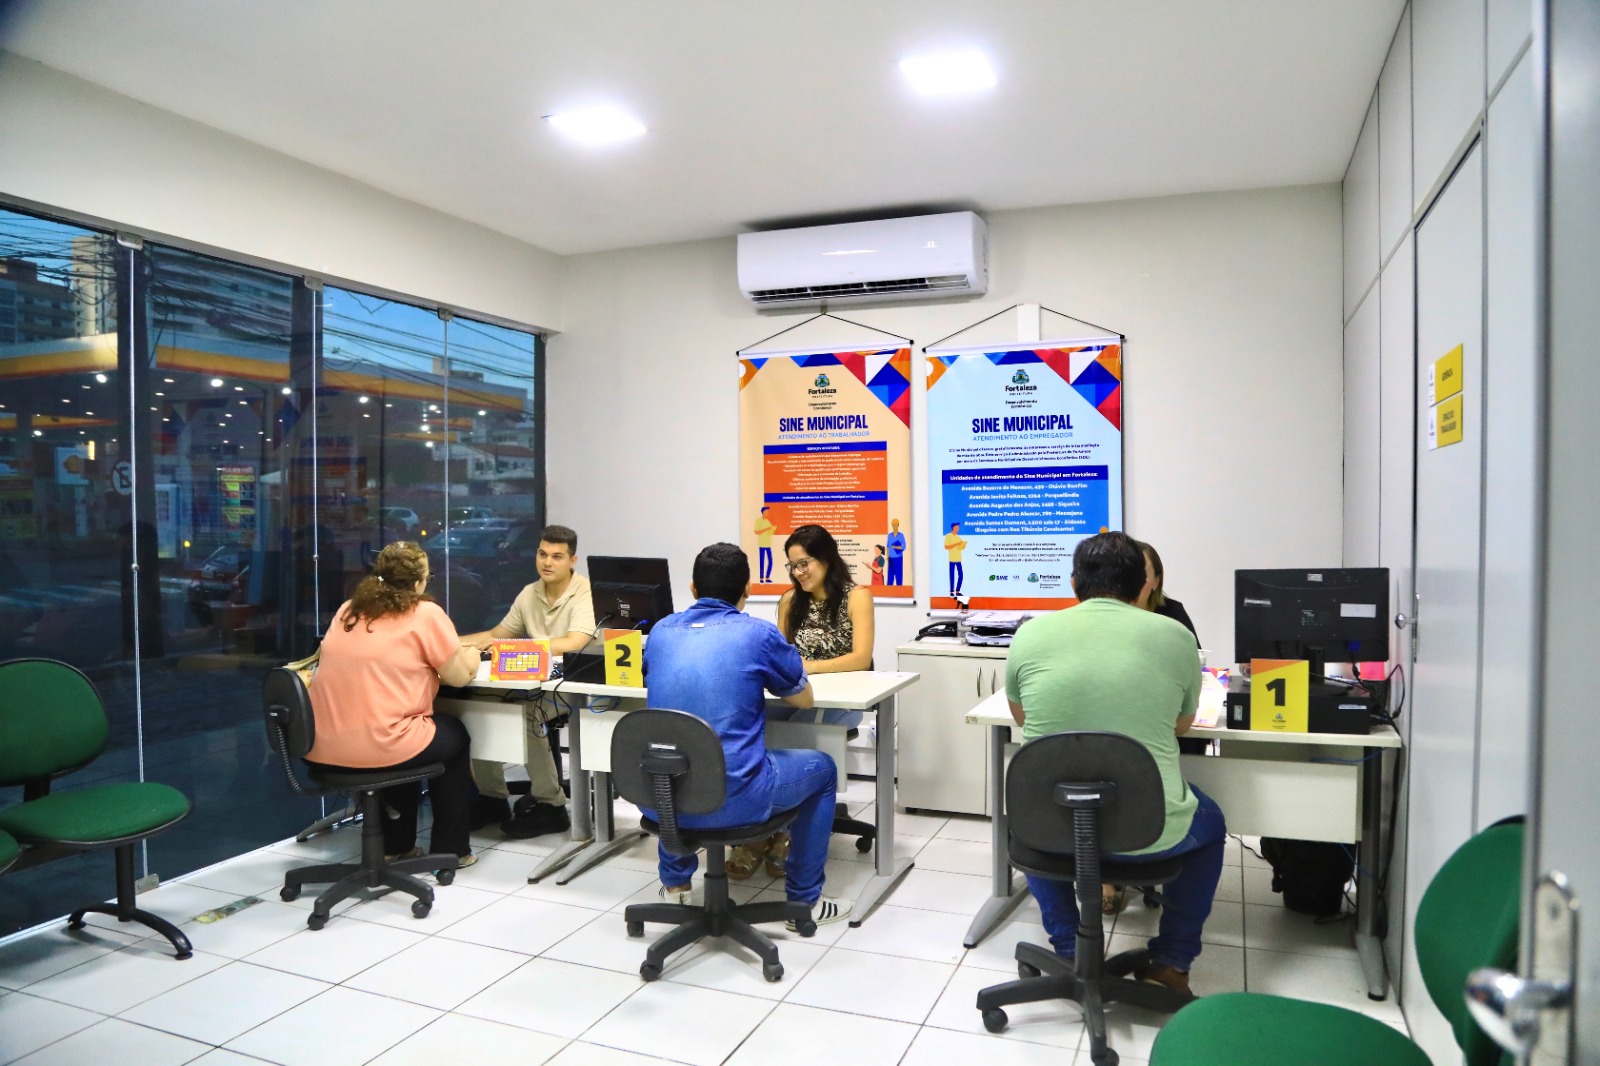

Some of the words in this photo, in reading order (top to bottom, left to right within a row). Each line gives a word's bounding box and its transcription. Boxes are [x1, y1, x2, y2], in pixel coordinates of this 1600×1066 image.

[780, 417, 804, 432] SINE
[807, 415, 868, 431] MUNICIPAL
[972, 418, 1000, 433] SINE
[1004, 414, 1073, 432] MUNICIPAL
[615, 644, 632, 667] 2
[1266, 678, 1286, 706] 1
